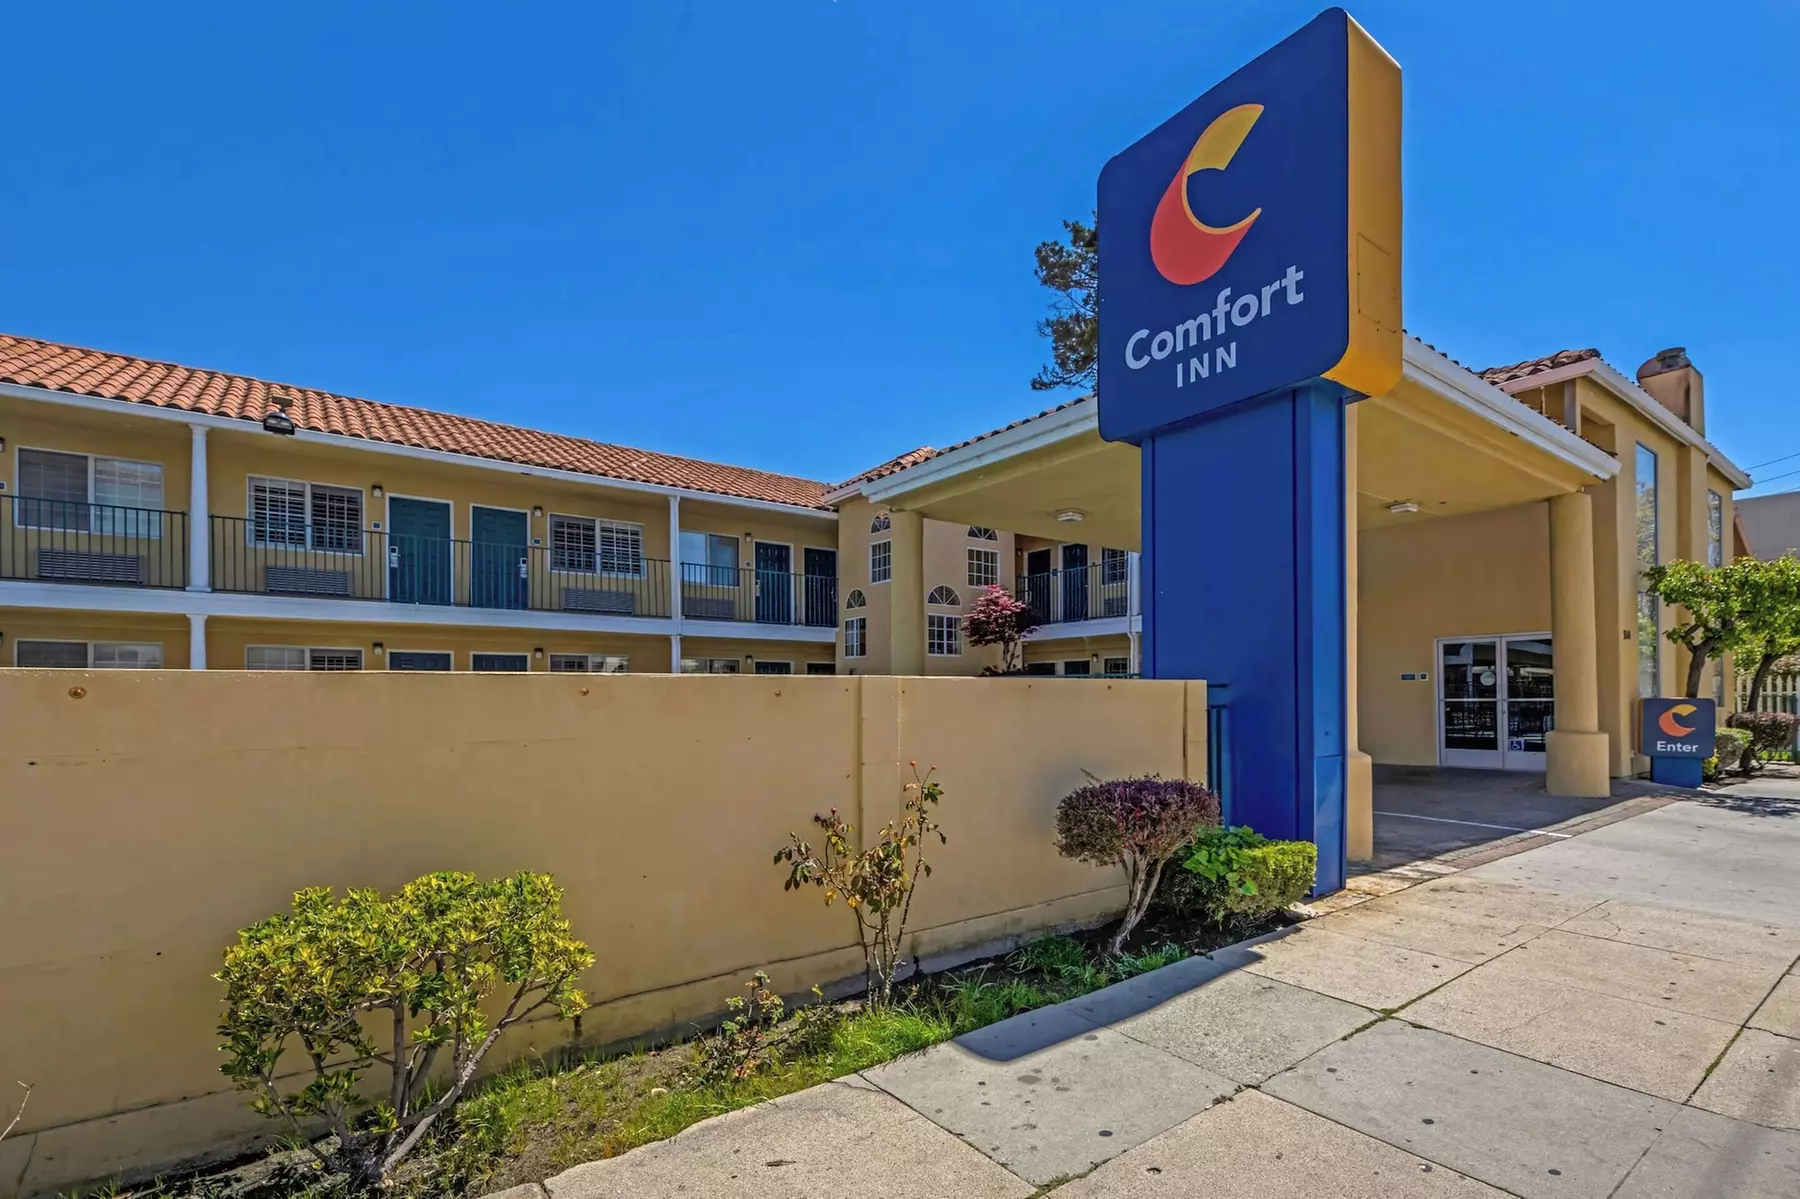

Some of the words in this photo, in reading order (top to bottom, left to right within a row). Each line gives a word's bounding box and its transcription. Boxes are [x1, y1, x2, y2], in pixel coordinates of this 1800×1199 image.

[1125, 265, 1304, 370] Comfort
[1176, 341, 1237, 388] INN
[1656, 740, 1699, 753] Enter
